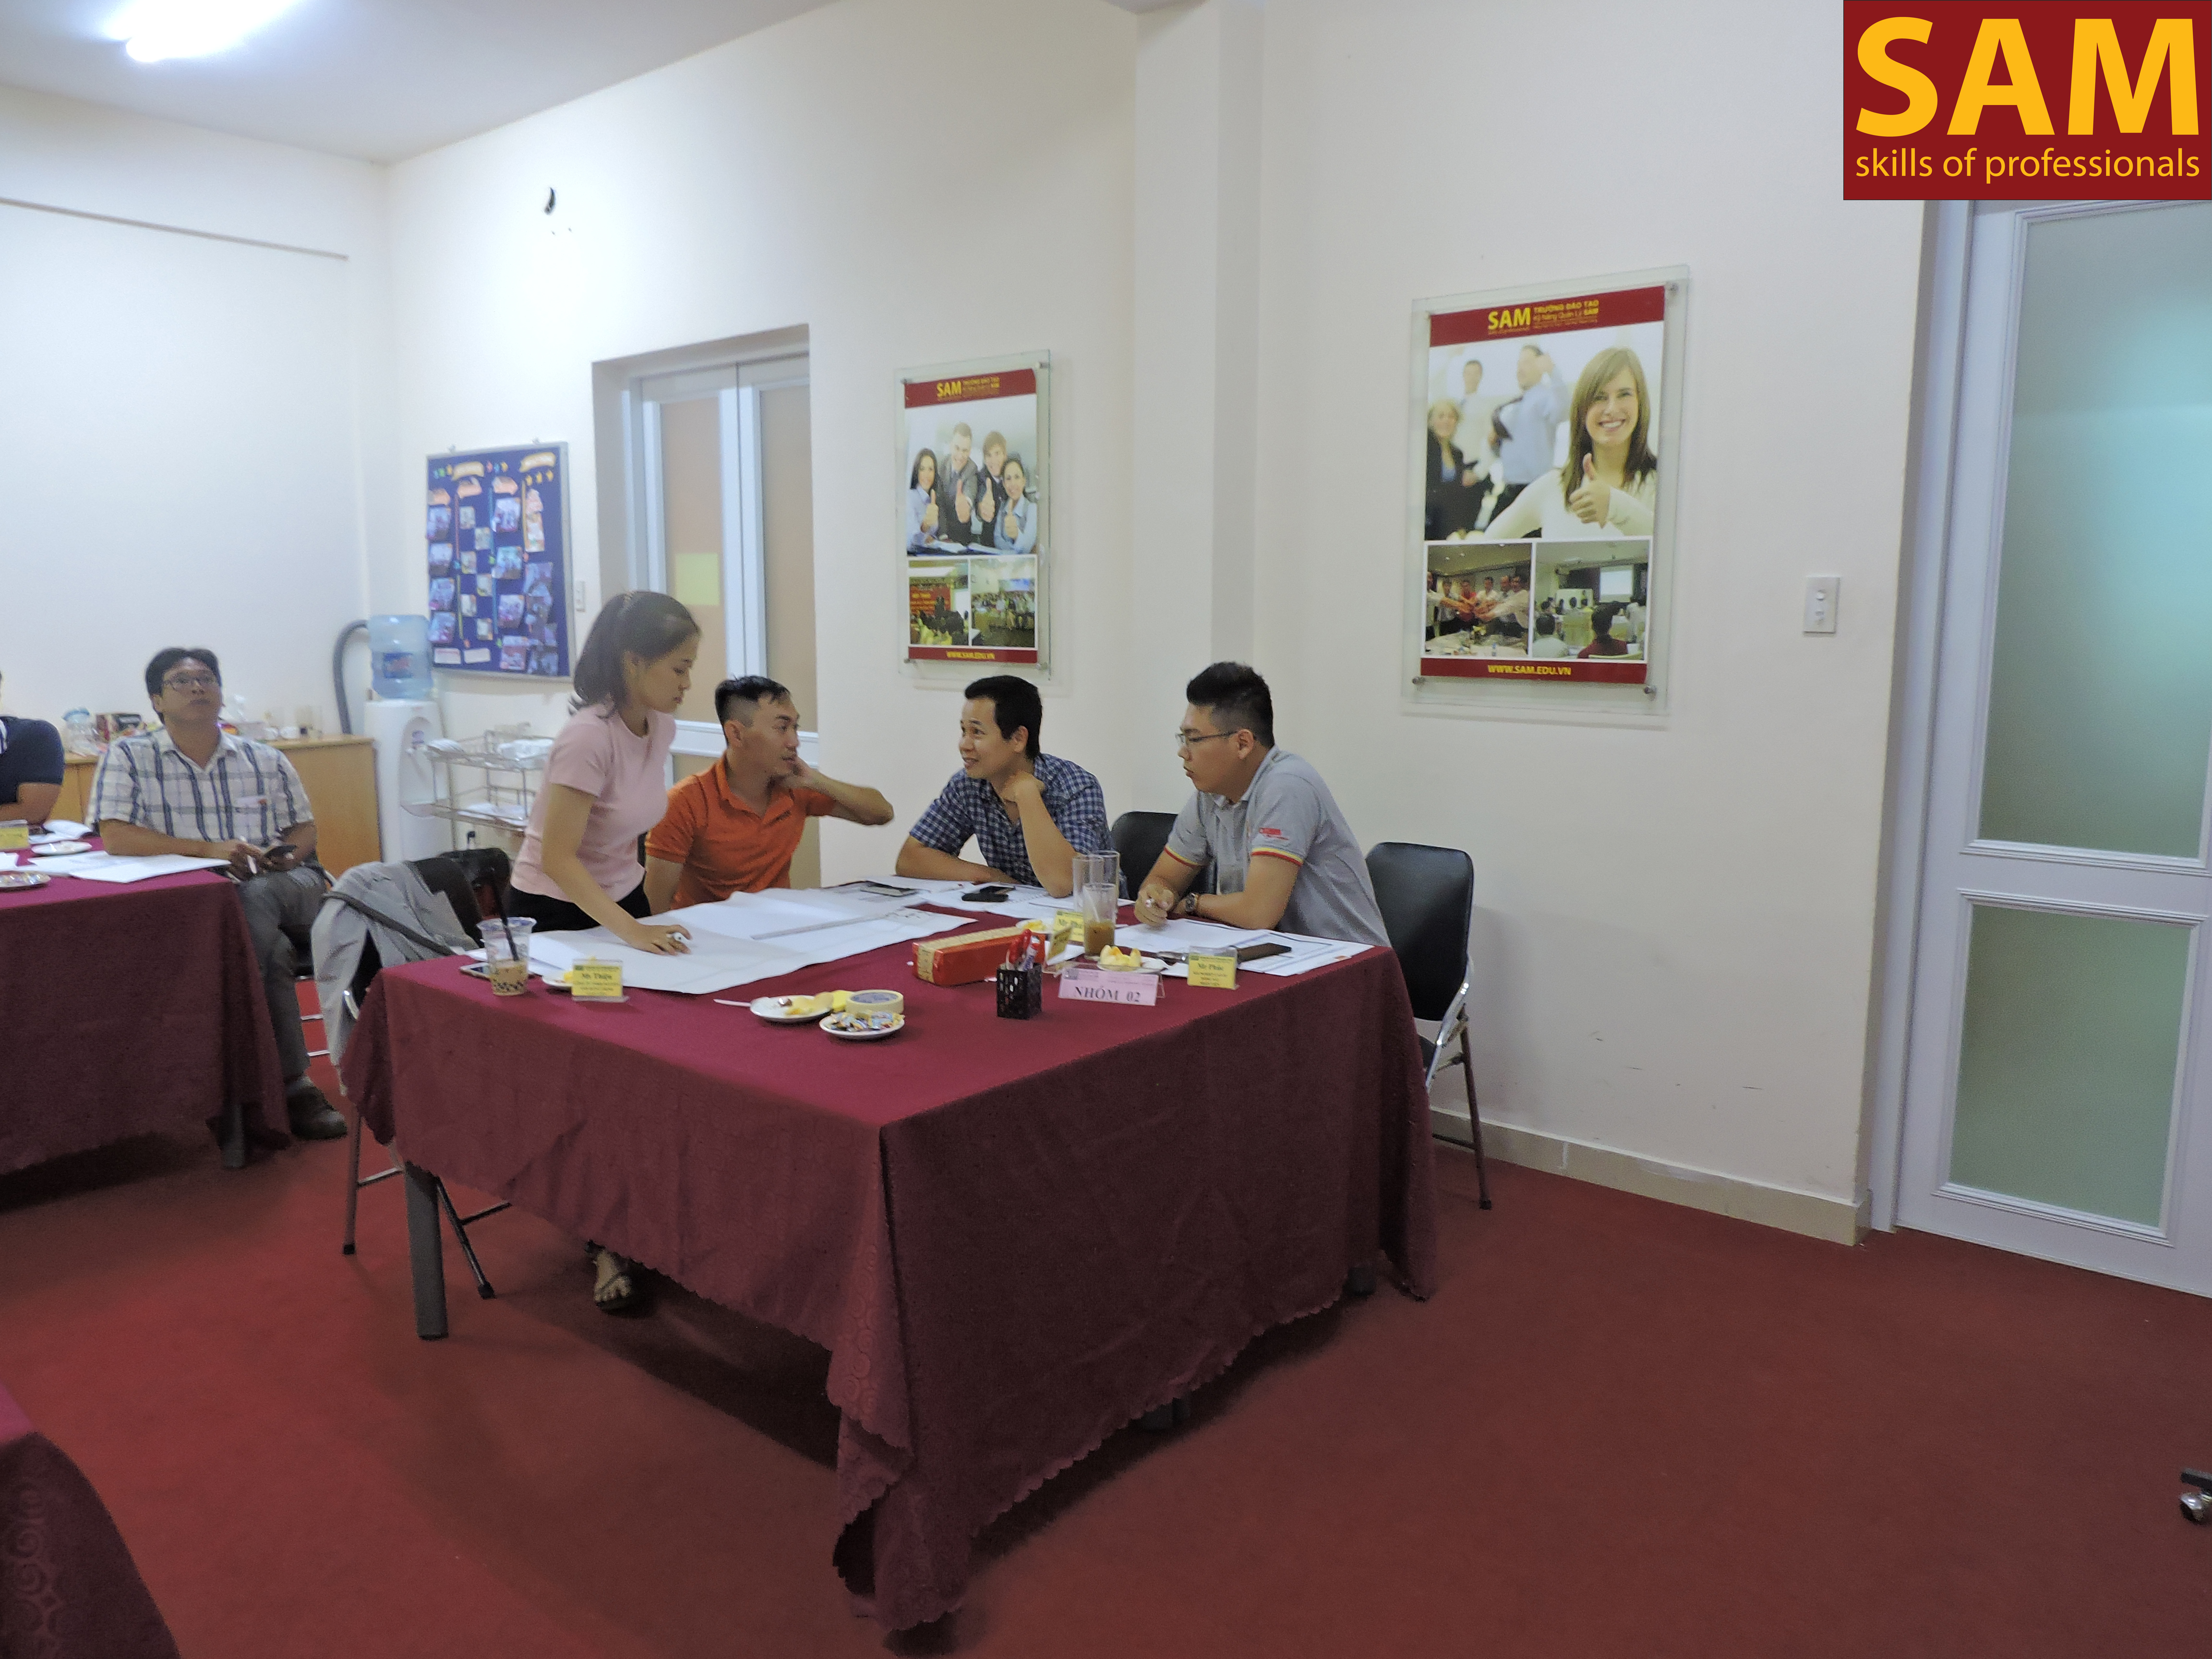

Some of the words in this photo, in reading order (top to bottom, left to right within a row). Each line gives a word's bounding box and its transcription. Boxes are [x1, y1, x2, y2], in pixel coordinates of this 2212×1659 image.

[1488, 307, 1530, 330] SAM
[937, 381, 962, 398] SAM
[1488, 665, 1571, 675] WWW.SAM.EDU.VN
[1126, 991, 1141, 1002] 02
